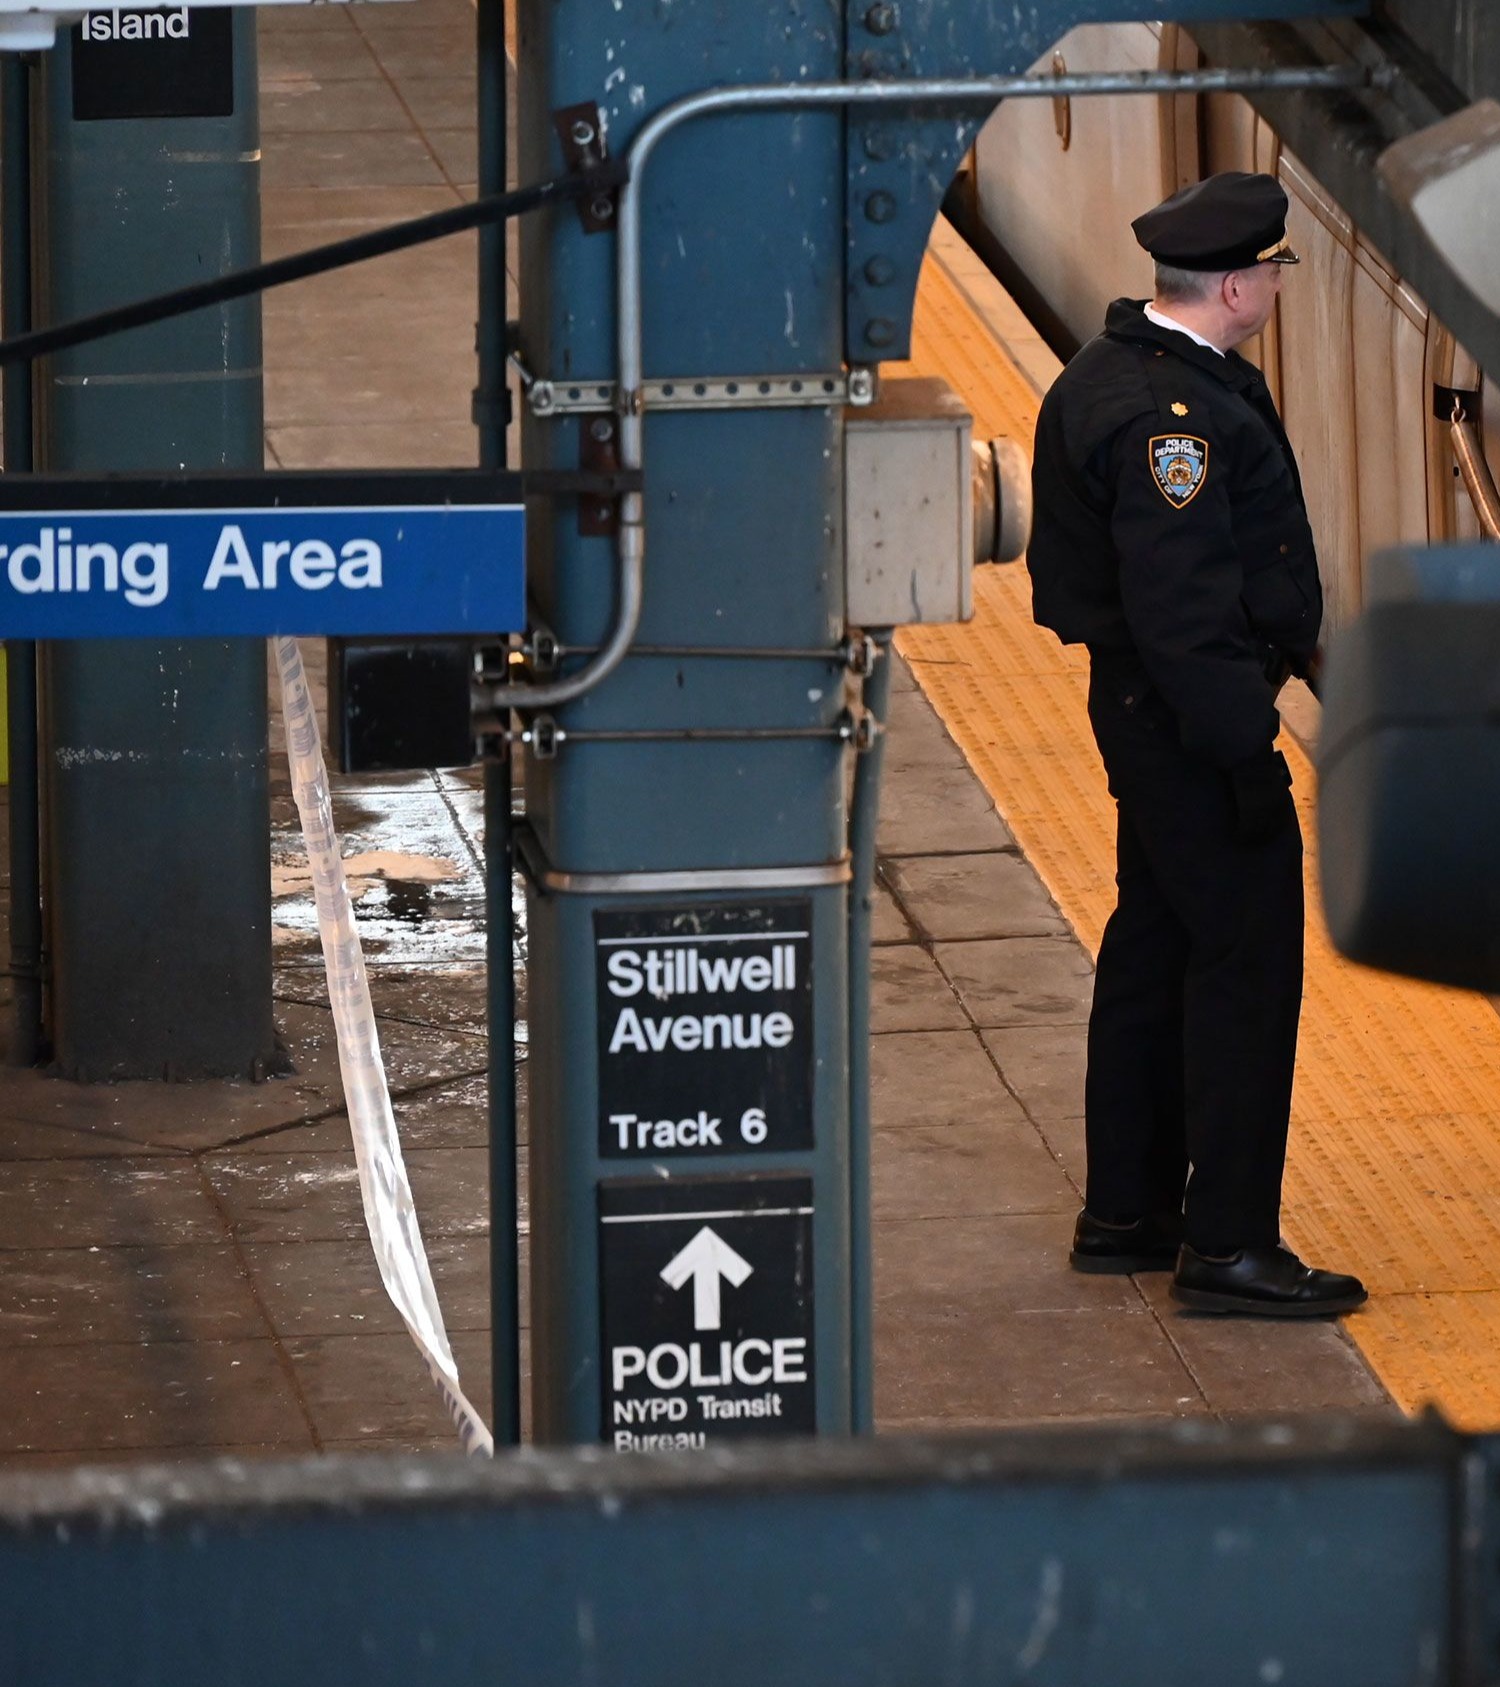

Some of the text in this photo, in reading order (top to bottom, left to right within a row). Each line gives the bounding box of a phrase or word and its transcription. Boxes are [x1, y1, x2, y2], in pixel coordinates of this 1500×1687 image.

[81, 6, 190, 41] Island
[1155, 446, 1203, 459] DEPARTMENT
[1165, 439, 1194, 448] POLICE
[1155, 466, 1173, 495] CITY OF
[0, 525, 383, 607] ding Area
[606, 945, 796, 998] Stillwell
[608, 1007, 794, 1054] Avenue
[608, 1108, 768, 1149] Track 6
[612, 1337, 807, 1391] POLICE
[613, 1393, 782, 1425] NYPD Transit
[614, 1431, 706, 1453] Bureau
